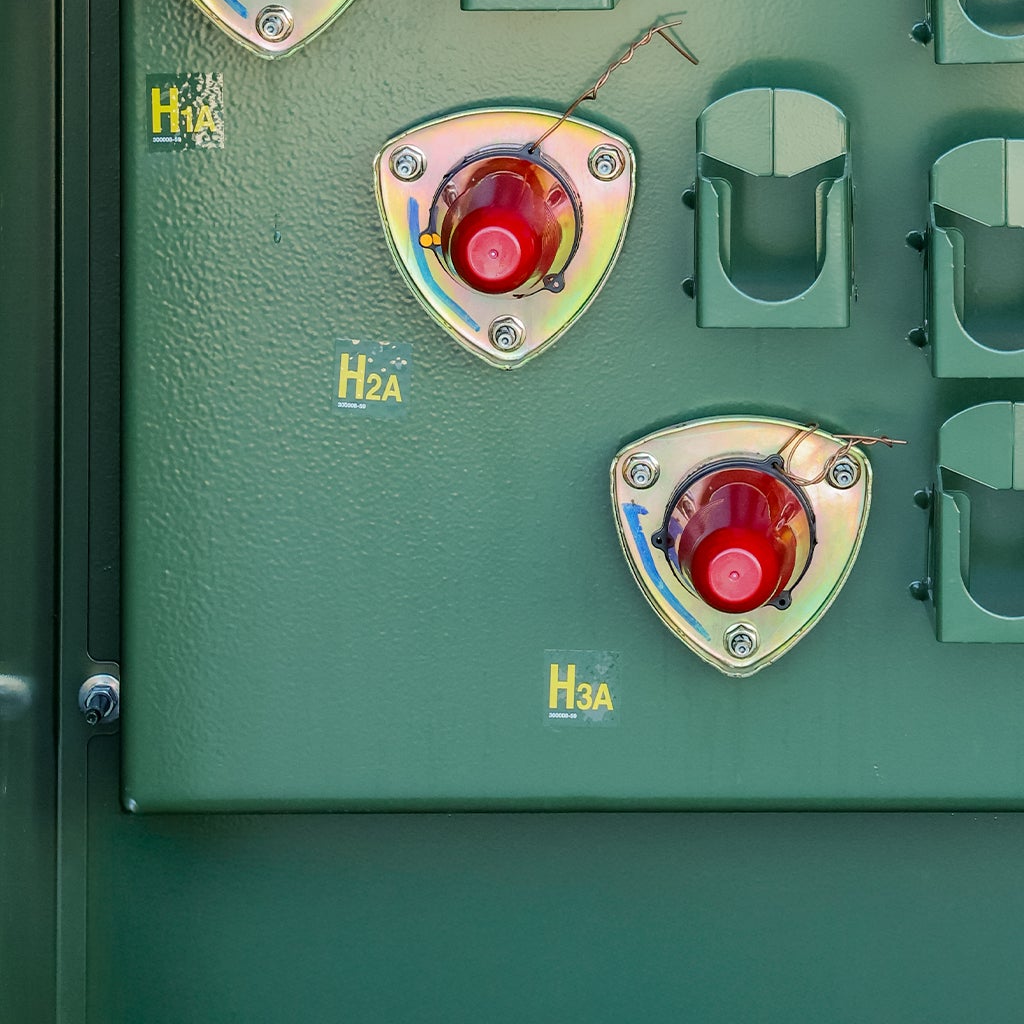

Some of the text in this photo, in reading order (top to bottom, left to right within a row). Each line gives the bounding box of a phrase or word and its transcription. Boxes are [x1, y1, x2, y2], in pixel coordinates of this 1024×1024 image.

[151, 87, 217, 134] H1A
[338, 352, 403, 403] H2A
[548, 663, 614, 711] H3A
